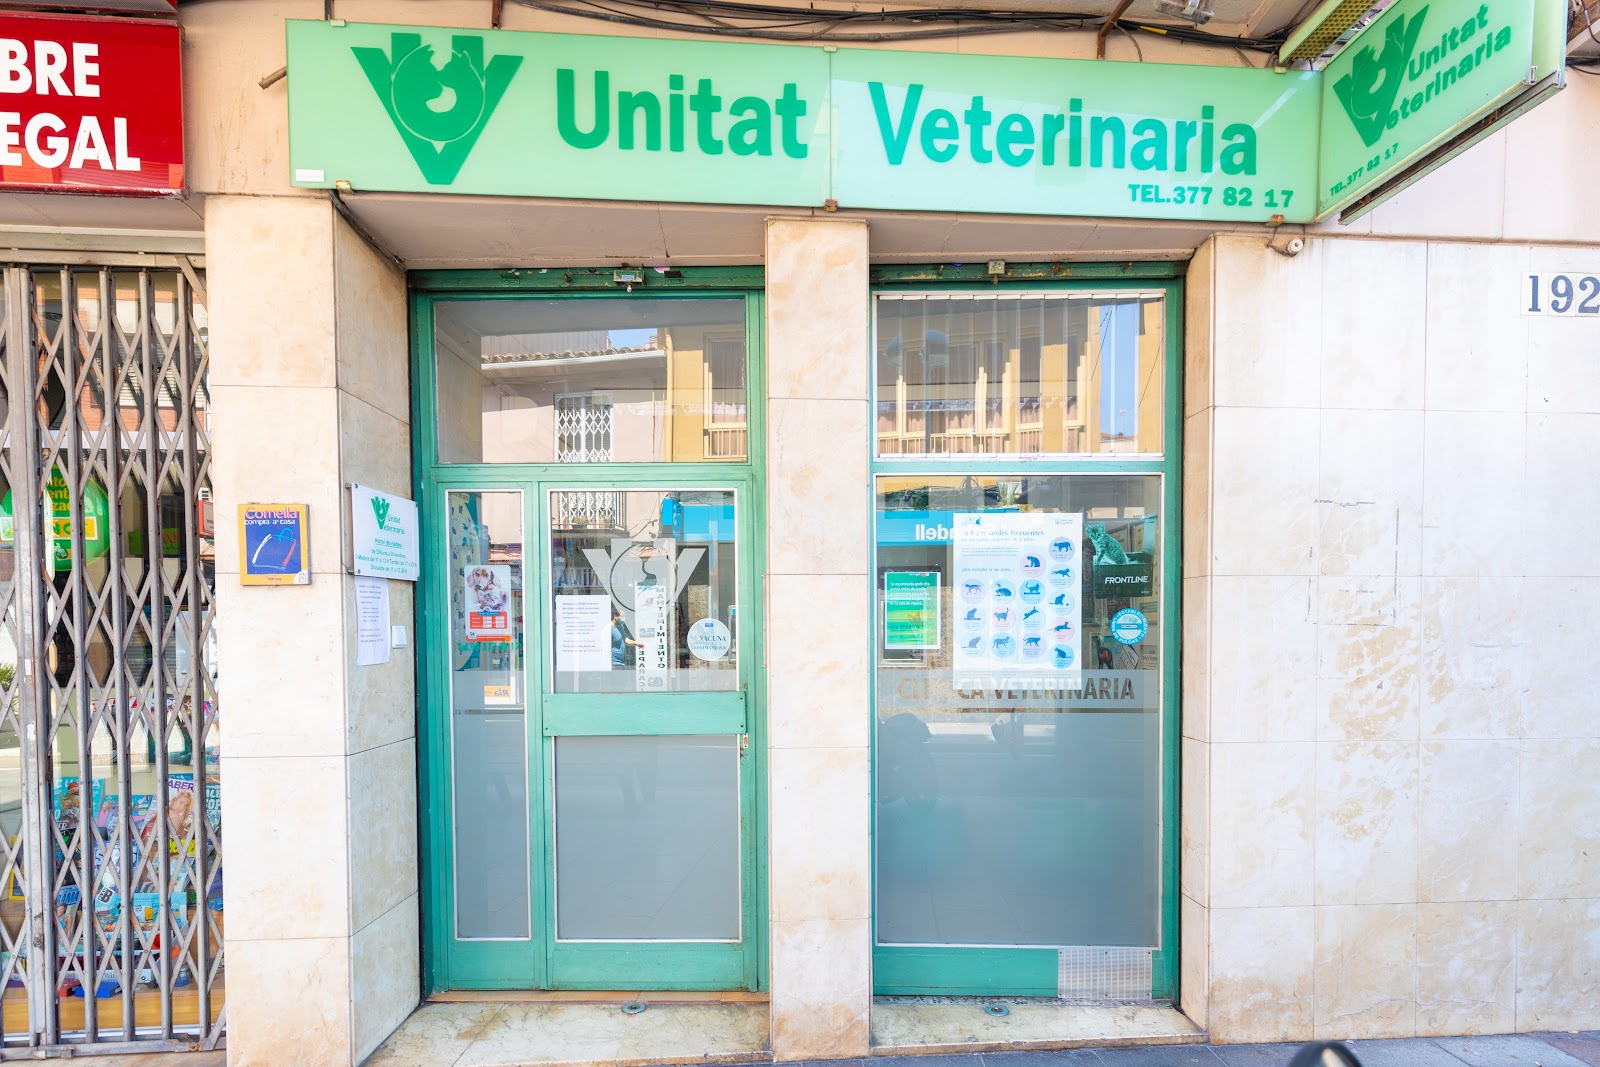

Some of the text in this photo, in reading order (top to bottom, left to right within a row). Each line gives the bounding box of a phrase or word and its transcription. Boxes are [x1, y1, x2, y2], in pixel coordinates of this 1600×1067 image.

[1407, 3, 1489, 82] Unitat
[556, 67, 1257, 177] Unitat Veterinaria
[1366, 155, 1381, 172] 82
[1384, 142, 1399, 160] 17
[1222, 186, 1253, 207] 82
[1263, 188, 1294, 209] 17
[994, 677, 1136, 700] VETERINARIA
